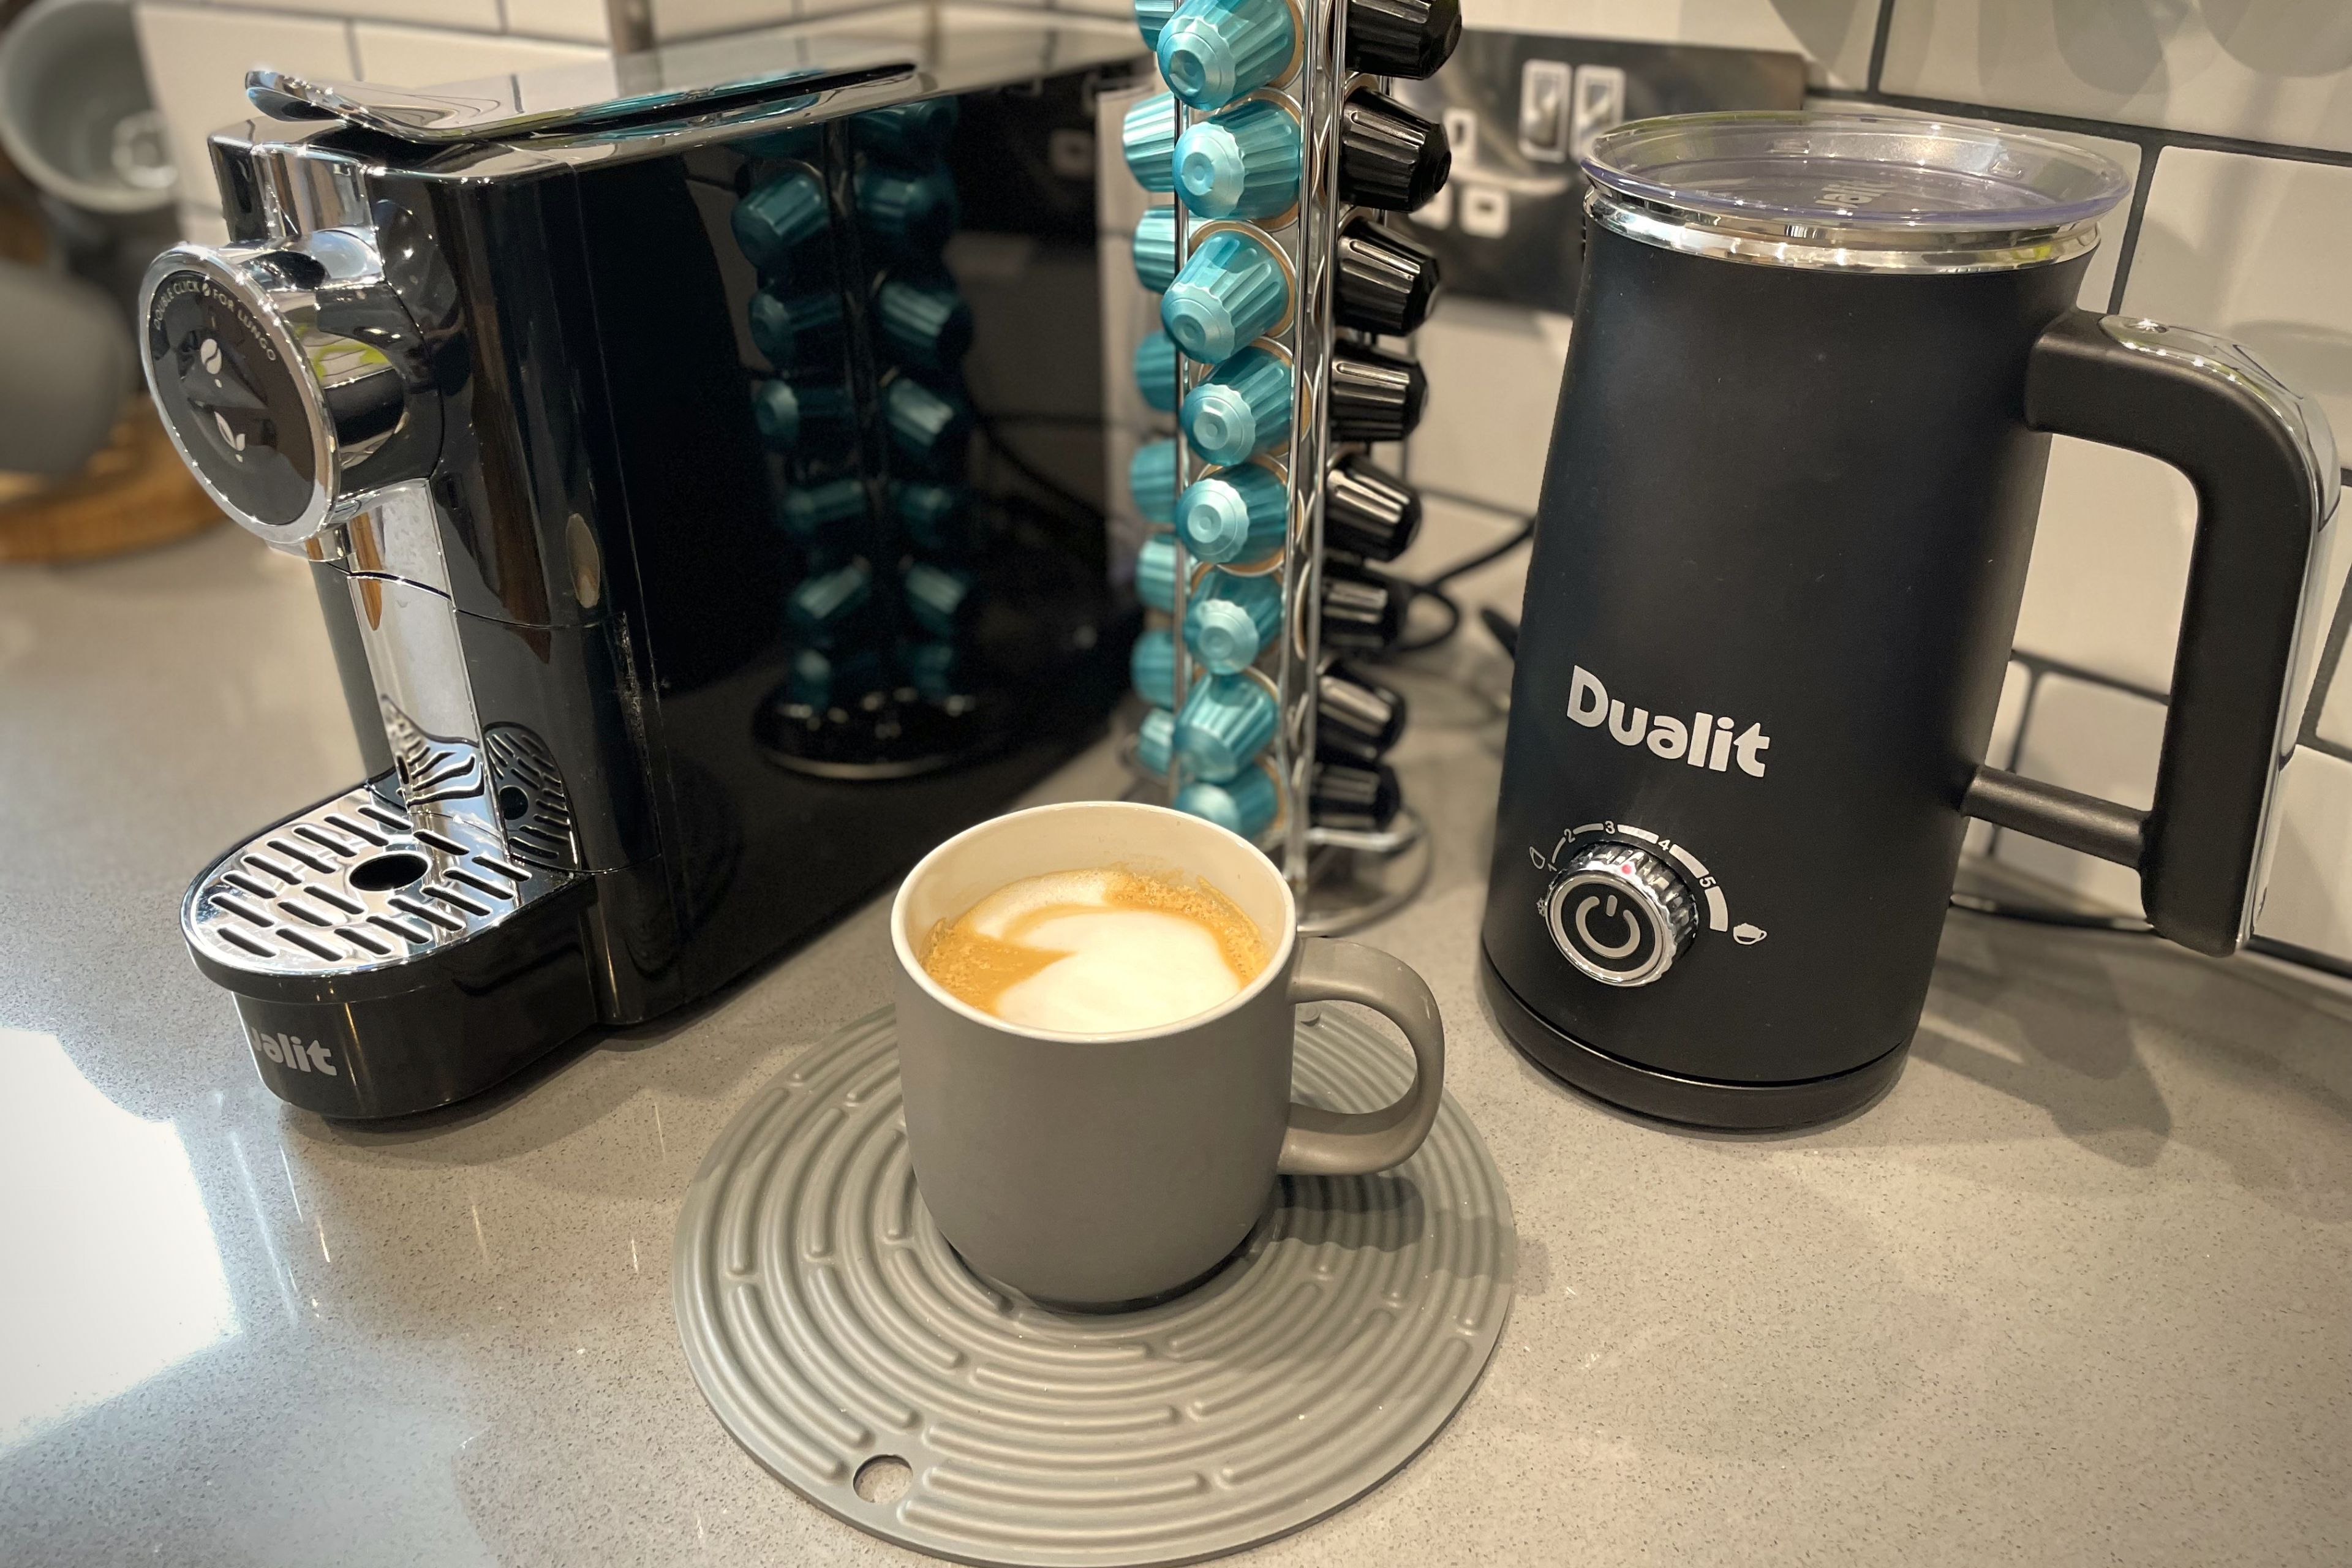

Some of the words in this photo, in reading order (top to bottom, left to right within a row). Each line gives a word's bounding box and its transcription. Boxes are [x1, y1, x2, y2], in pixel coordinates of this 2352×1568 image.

[154, 287, 175, 331] DOUBLE
[174, 280, 200, 295] CLICK
[213, 288, 234, 312] FOR
[238, 309, 276, 361] LUNGO
[1566, 665, 1771, 778] Dualit
[1563, 828, 1576, 843] 2
[1605, 820, 1616, 834] 3
[1658, 839, 1671, 851] 4
[1699, 876, 1716, 888] 5
